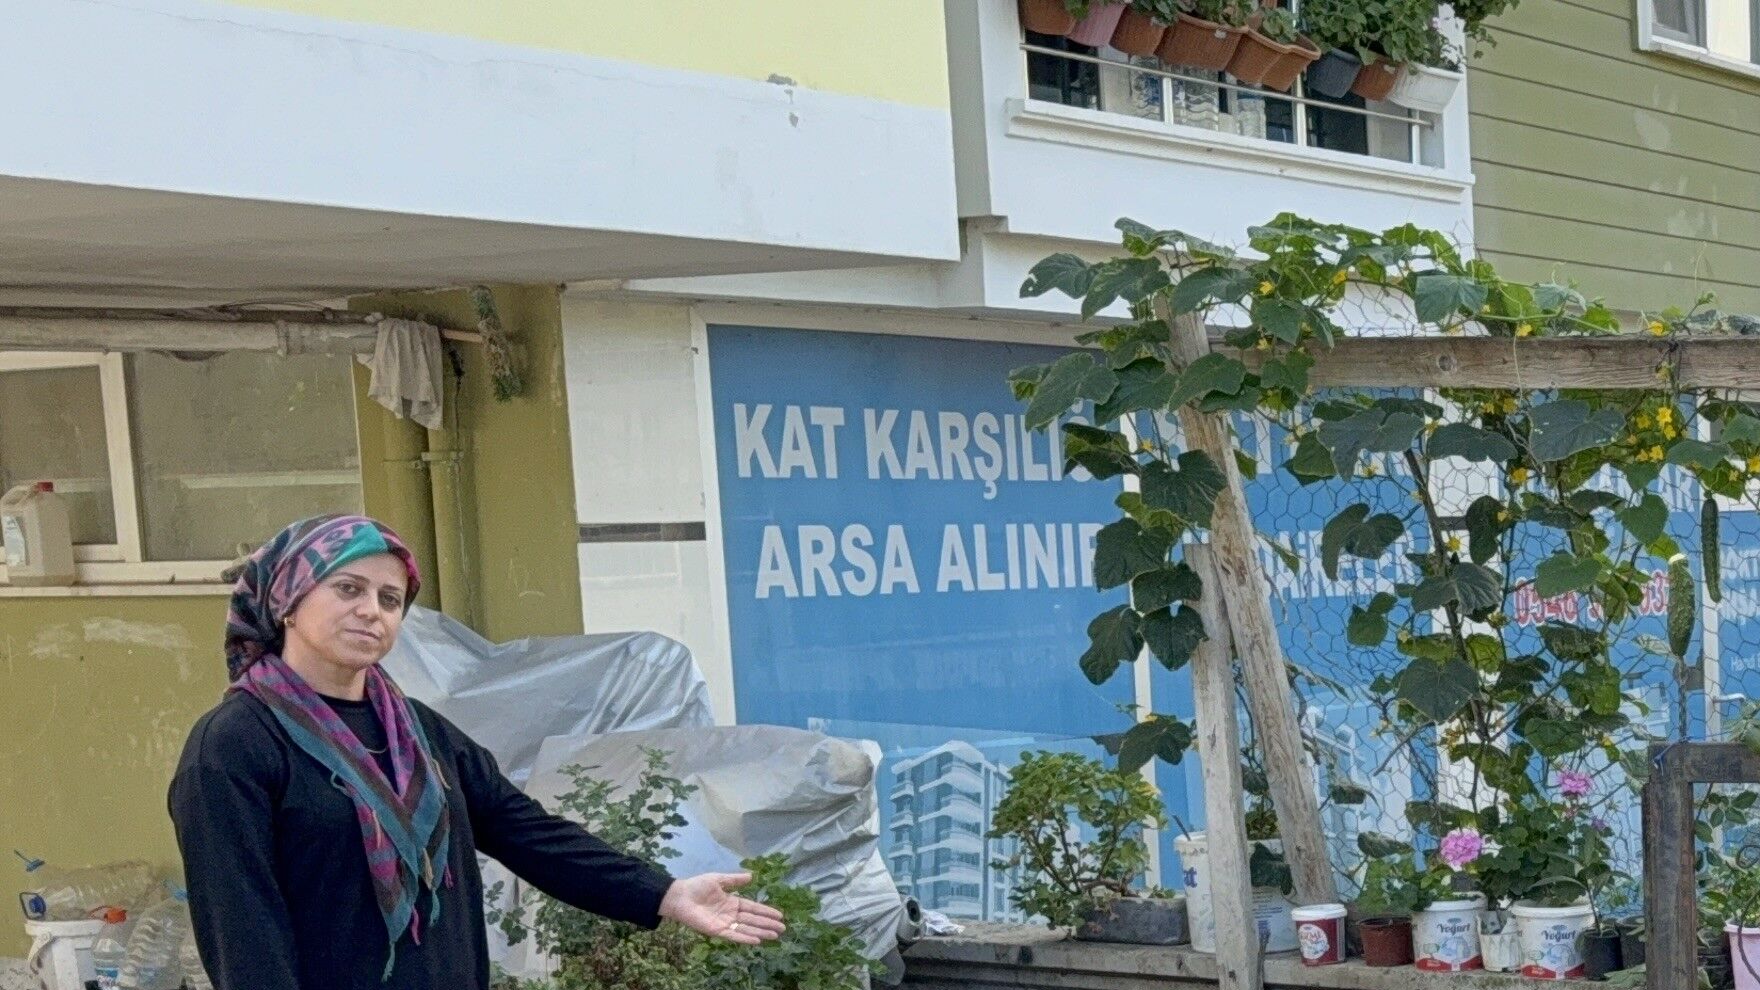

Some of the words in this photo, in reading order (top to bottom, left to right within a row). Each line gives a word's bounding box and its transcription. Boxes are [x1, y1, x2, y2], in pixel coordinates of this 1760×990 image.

[734, 402, 845, 479] KAT
[864, 399, 1107, 500] KARŞILI
[755, 524, 921, 599] ARSA
